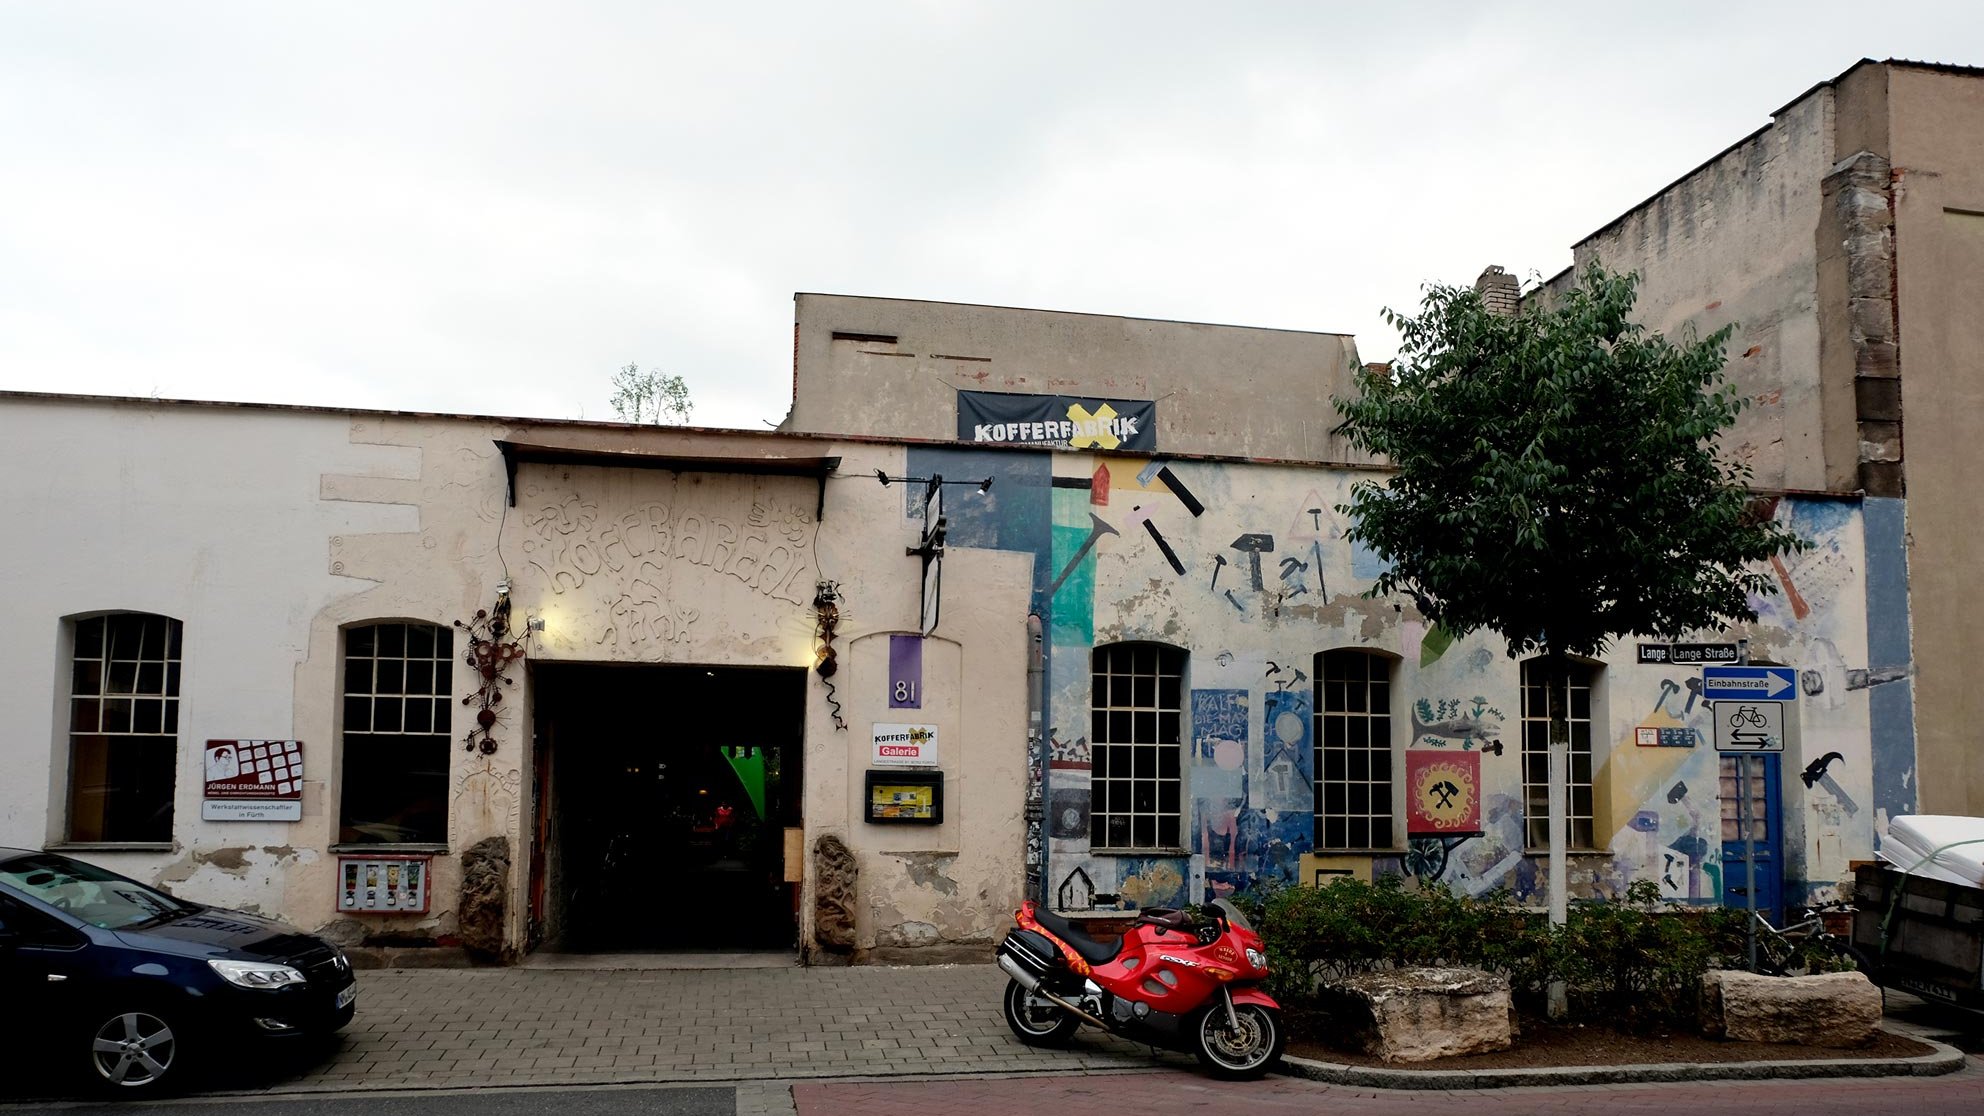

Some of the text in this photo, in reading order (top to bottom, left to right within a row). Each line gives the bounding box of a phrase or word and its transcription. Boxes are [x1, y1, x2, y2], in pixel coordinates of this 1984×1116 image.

[974, 416, 1139, 442] KOFFERFABRIK
[1641, 646, 1666, 661] Lange
[1673, 647, 1735, 661] Lange Straße
[1708, 679, 1769, 688] Einbahnstraße
[894, 680, 915, 703] 81
[874, 731, 935, 744] KOFFERFABRIK
[882, 747, 917, 756] Galerie
[207, 782, 236, 790] JÜRGEN
